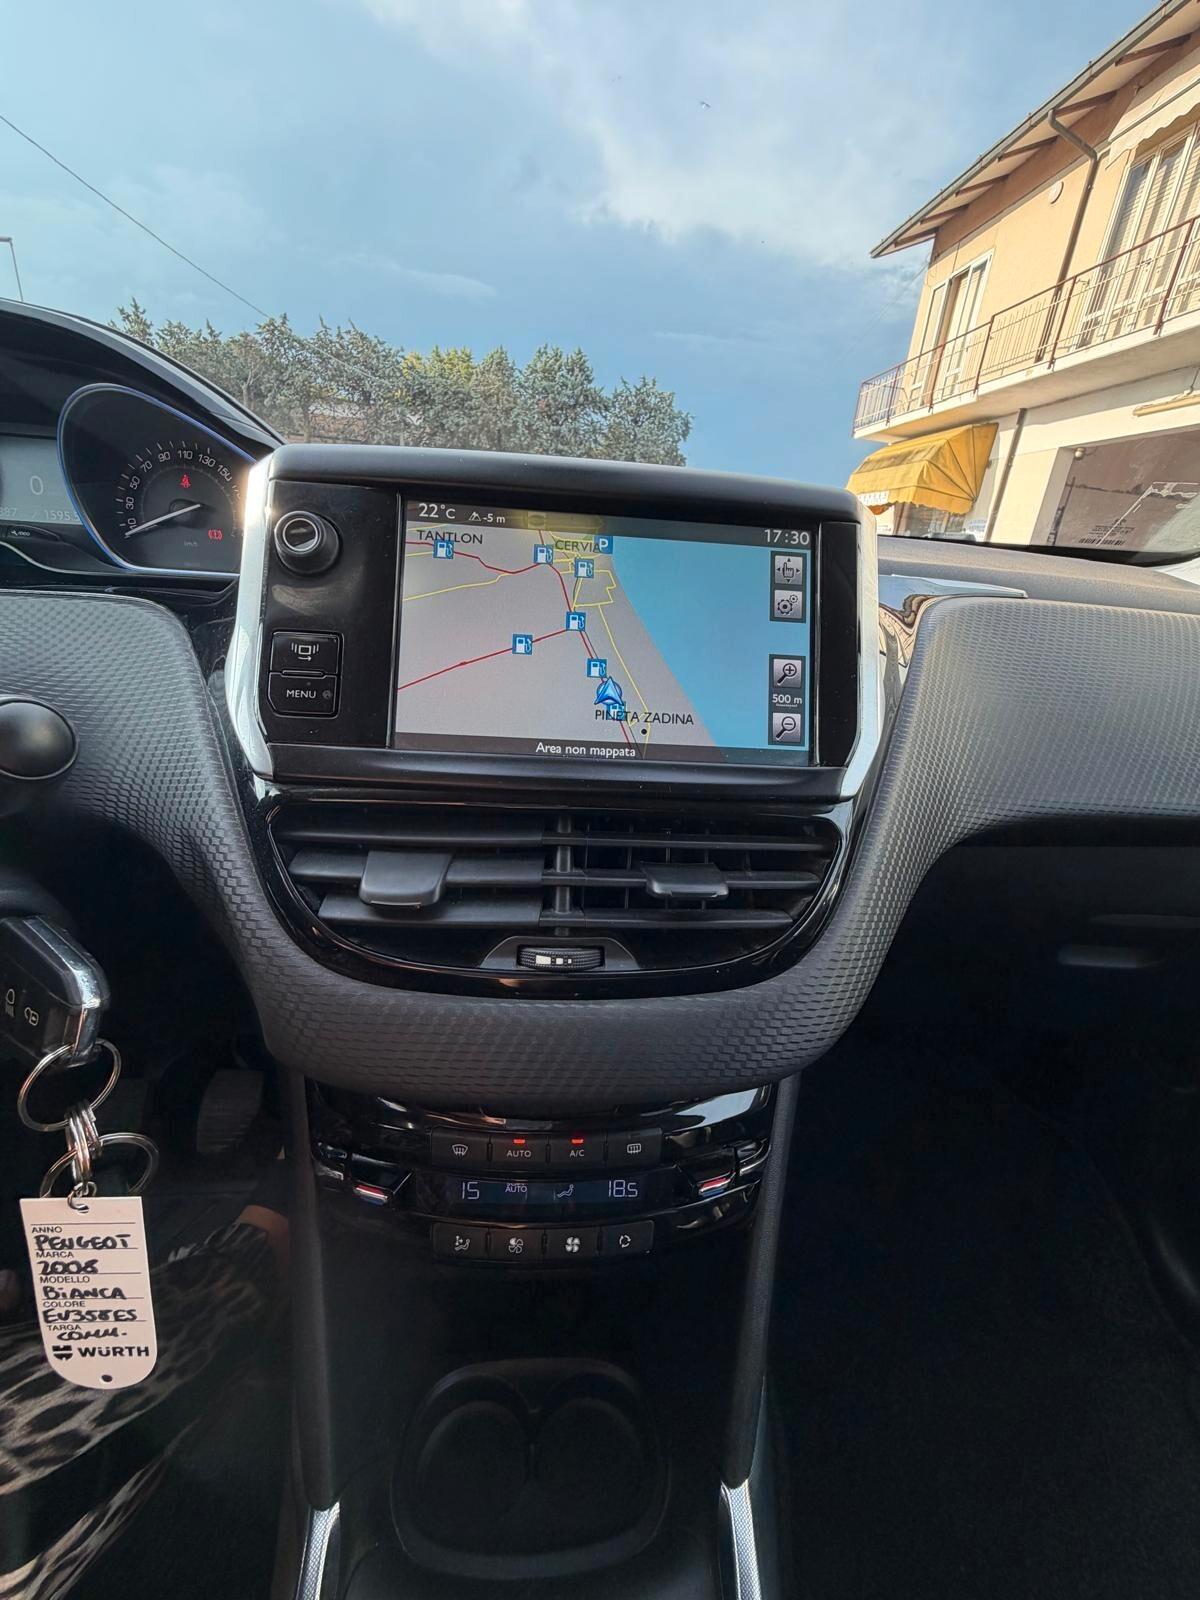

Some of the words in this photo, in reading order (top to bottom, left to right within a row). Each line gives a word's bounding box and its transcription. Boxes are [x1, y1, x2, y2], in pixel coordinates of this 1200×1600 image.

[158, 451, 171, 462] 90
[177, 450, 193, 460] 110
[198, 454, 216, 468] 130
[140, 460, 153, 472] 70
[217, 464, 233, 481] 150
[29, 475, 44, 496] 0
[129, 475, 141, 490] 50
[125, 496, 135, 510] 30
[416, 529, 483, 545] TANTLON
[764, 528, 810, 545] 17:30
[555, 540, 601, 553] CERVIA
[285, 689, 317, 700] MENU
[772, 693, 792, 704] 500
[793, 696, 803, 705] m
[595, 709, 640, 723] PINETA
[643, 711, 694, 725] ZADINA
[535, 742, 562, 754] Area
[565, 746, 586, 756] non
[589, 748, 636, 759] mappata
[506, 1149, 532, 1158] AUTO
[569, 1149, 585, 1158] A/C
[504, 1184, 528, 1193] AUTO
[31, 1226, 63, 1234] ANNO
[34, 1234, 131, 1251] PEUGEOT
[40, 1275, 90, 1283] MODELLO
[78, 1346, 150, 1357] WÜRTH
